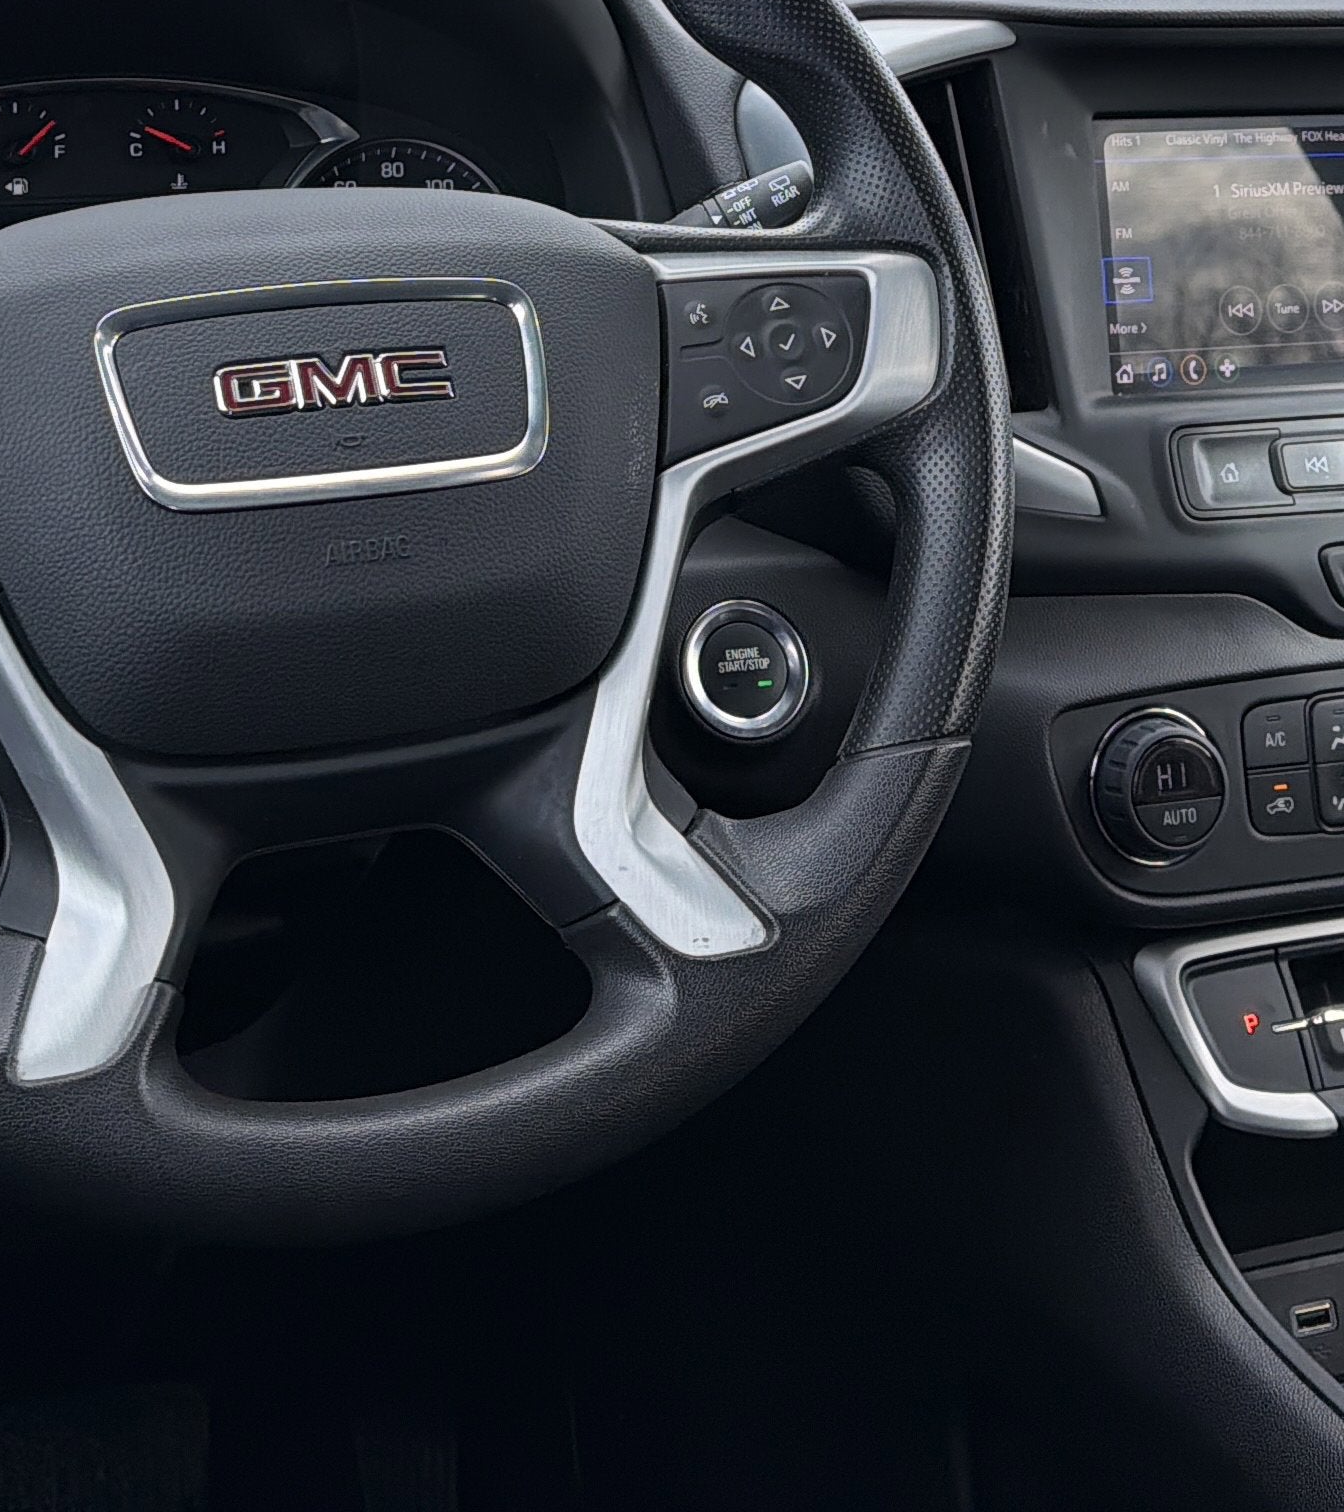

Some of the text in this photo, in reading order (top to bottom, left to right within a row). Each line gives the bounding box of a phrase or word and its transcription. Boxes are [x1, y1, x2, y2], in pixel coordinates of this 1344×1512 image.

[1111, 135, 1142, 147] Hits 1
[1165, 133, 1228, 148] Classic Vinyl
[1233, 132, 1253, 144] The
[1302, 130, 1324, 142] FOX
[53, 144, 65, 160] F
[130, 143, 143, 158] C
[212, 141, 226, 155] H
[380, 161, 404, 178] 80
[1111, 181, 1130, 192] AM
[1213, 181, 1344, 199] 1 SiriusXM Preview
[732, 195, 752, 213] OFF
[770, 185, 801, 208] REAR
[738, 207, 758, 226] INT
[1115, 227, 1133, 239] FM
[1274, 302, 1301, 314] Tune
[1109, 322, 1139, 335] More
[213, 350, 455, 418] GMC
[324, 534, 411, 568] AIRBAG
[725, 646, 761, 661] ENGINE
[717, 657, 770, 674] START/STOP
[1265, 731, 1287, 748] A/C
[1163, 807, 1197, 827] AUTO
[1243, 1013, 1259, 1035] P
